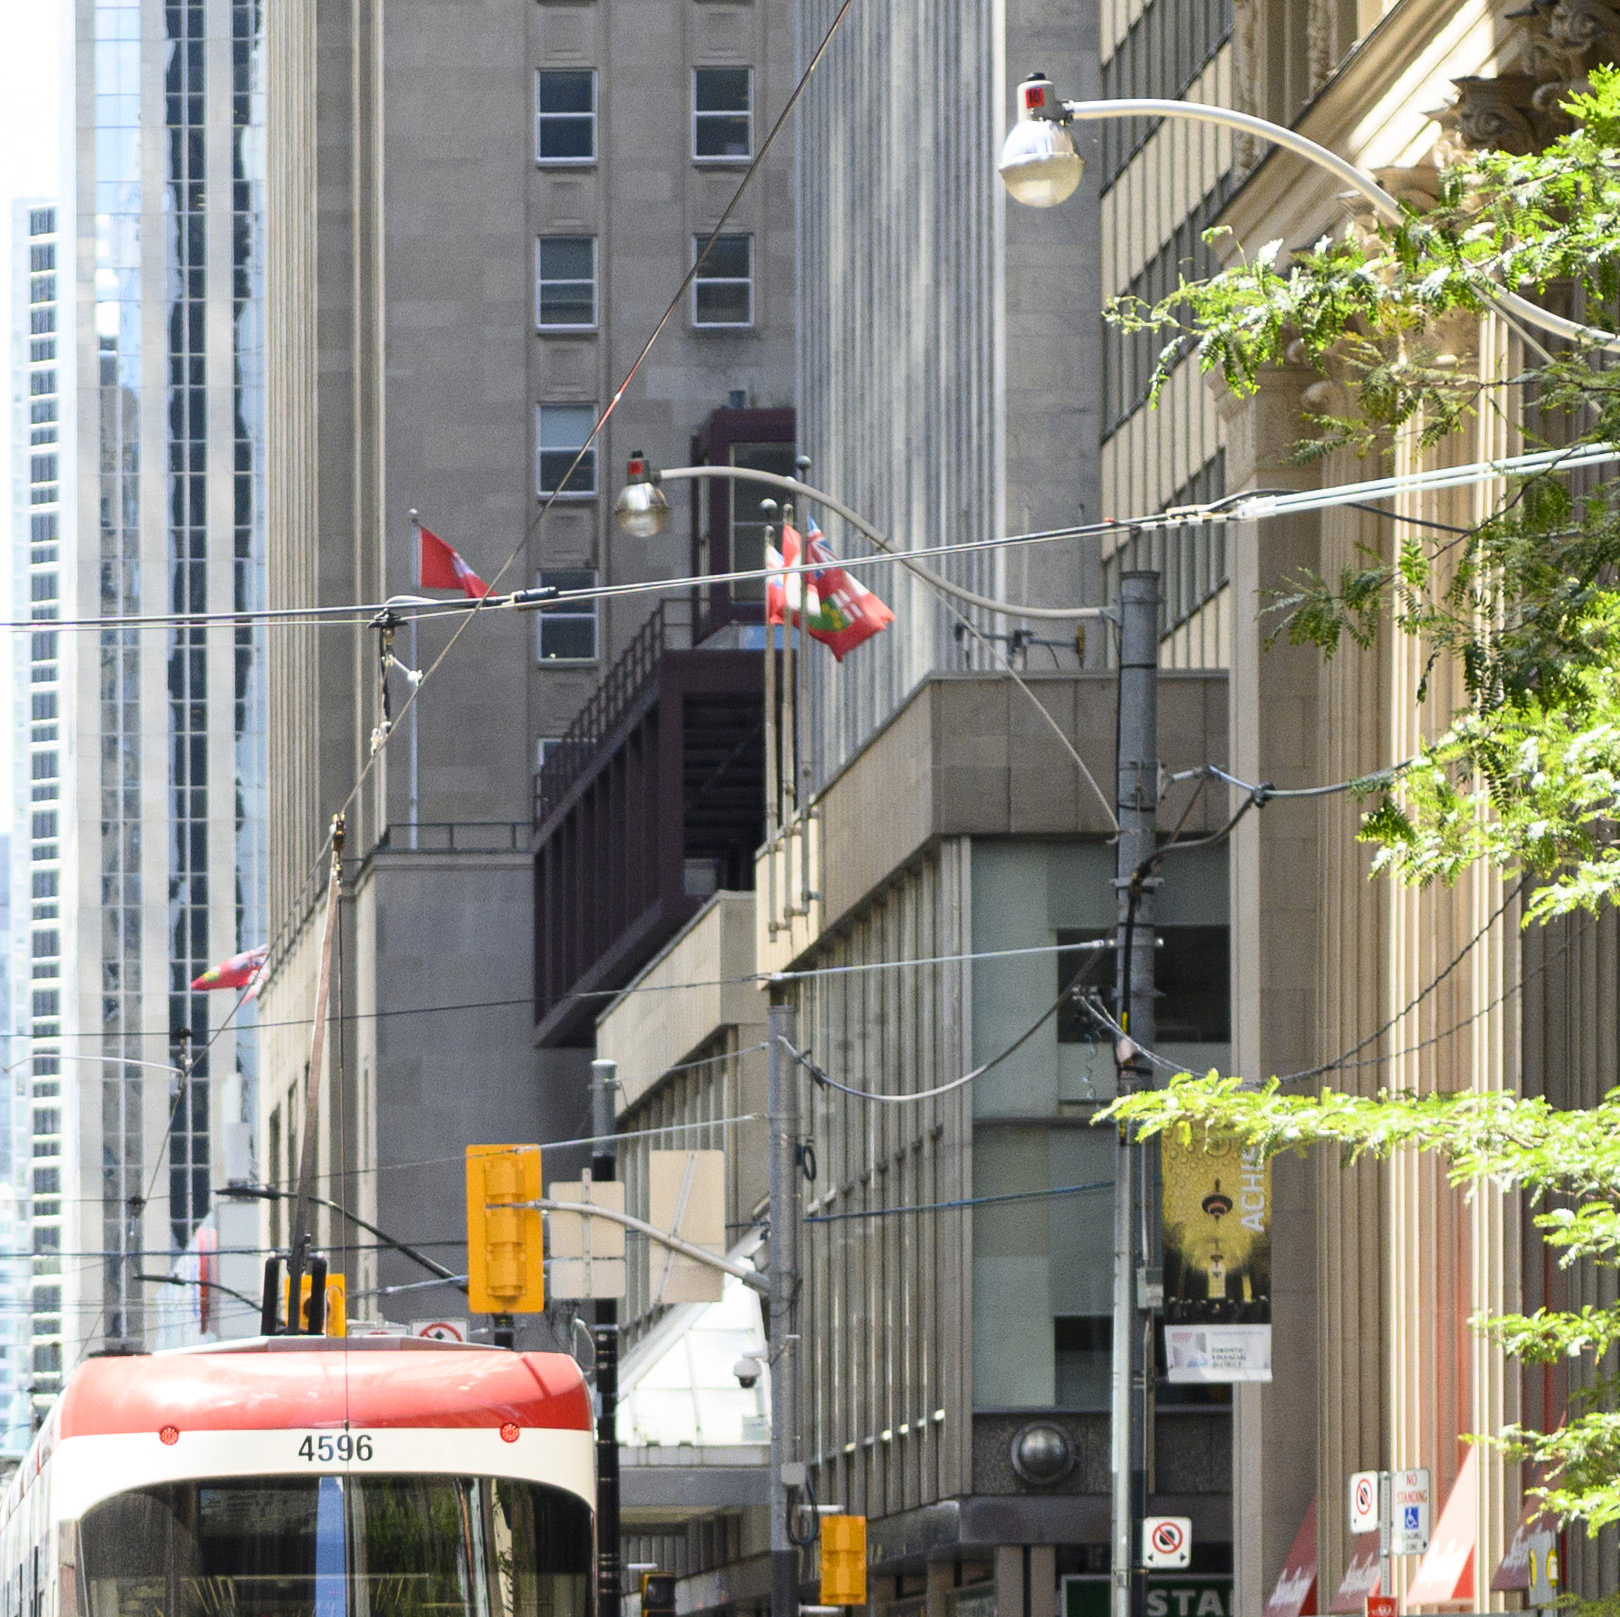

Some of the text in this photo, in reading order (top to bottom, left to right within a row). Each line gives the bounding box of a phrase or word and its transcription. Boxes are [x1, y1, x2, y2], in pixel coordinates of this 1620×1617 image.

[298, 1434, 373, 1462] 4596
[1406, 1473, 1418, 1486] NO
[1397, 1489, 1428, 1505] STANDING
[1146, 1589, 1234, 1617] STA
